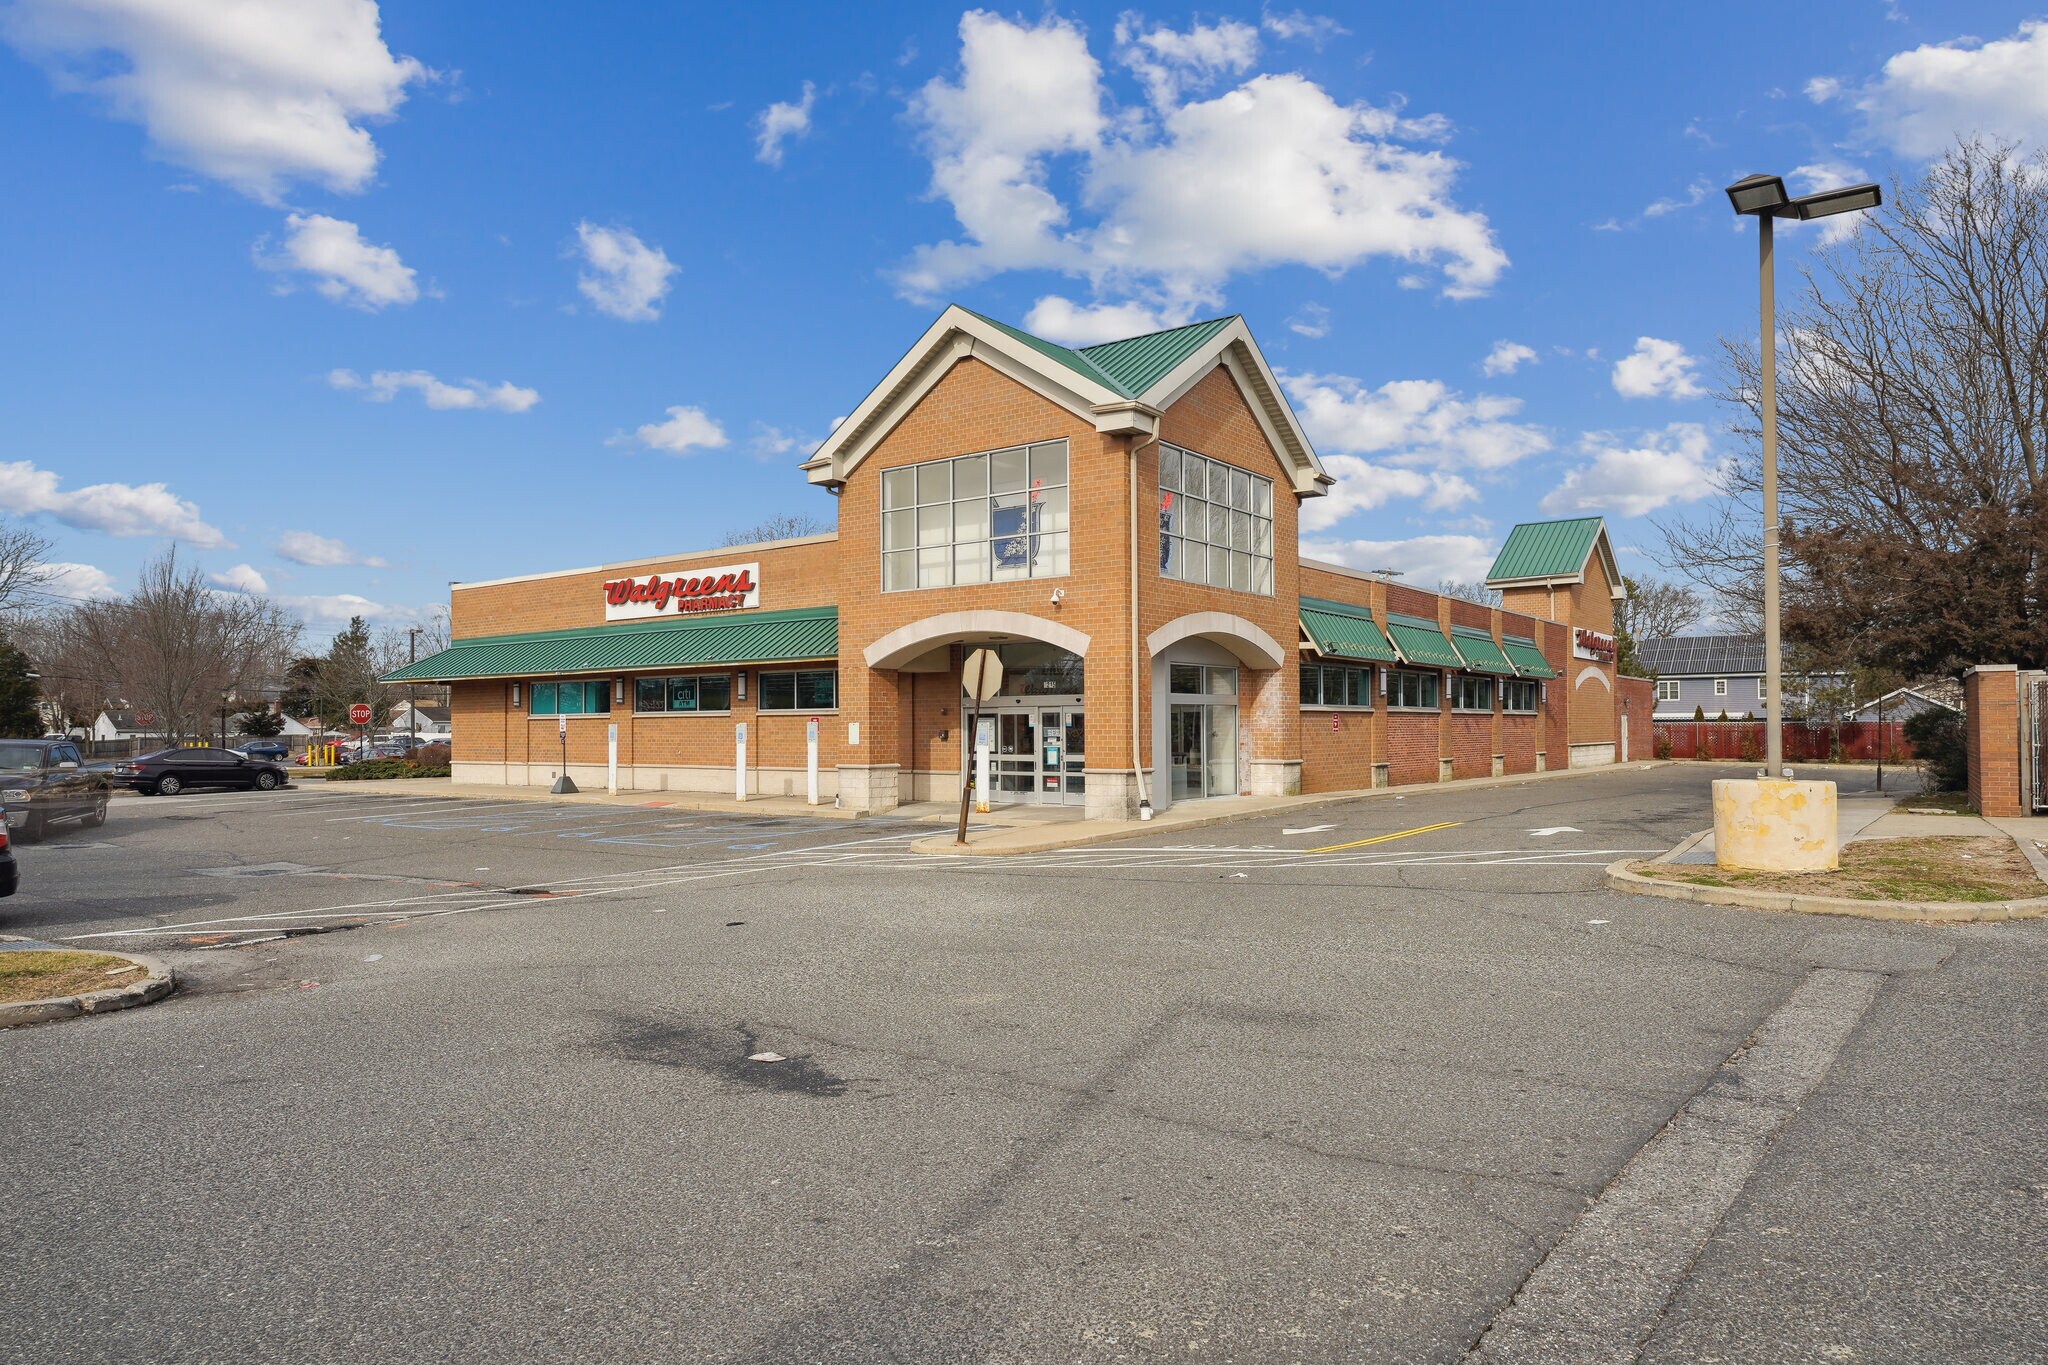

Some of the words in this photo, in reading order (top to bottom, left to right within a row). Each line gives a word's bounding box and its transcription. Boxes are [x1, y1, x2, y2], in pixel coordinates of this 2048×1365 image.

[603, 569, 756, 610] Walgreens
[678, 594, 746, 612] PHARMACY
[677, 688, 691, 700] citi
[352, 710, 371, 718] STOP
